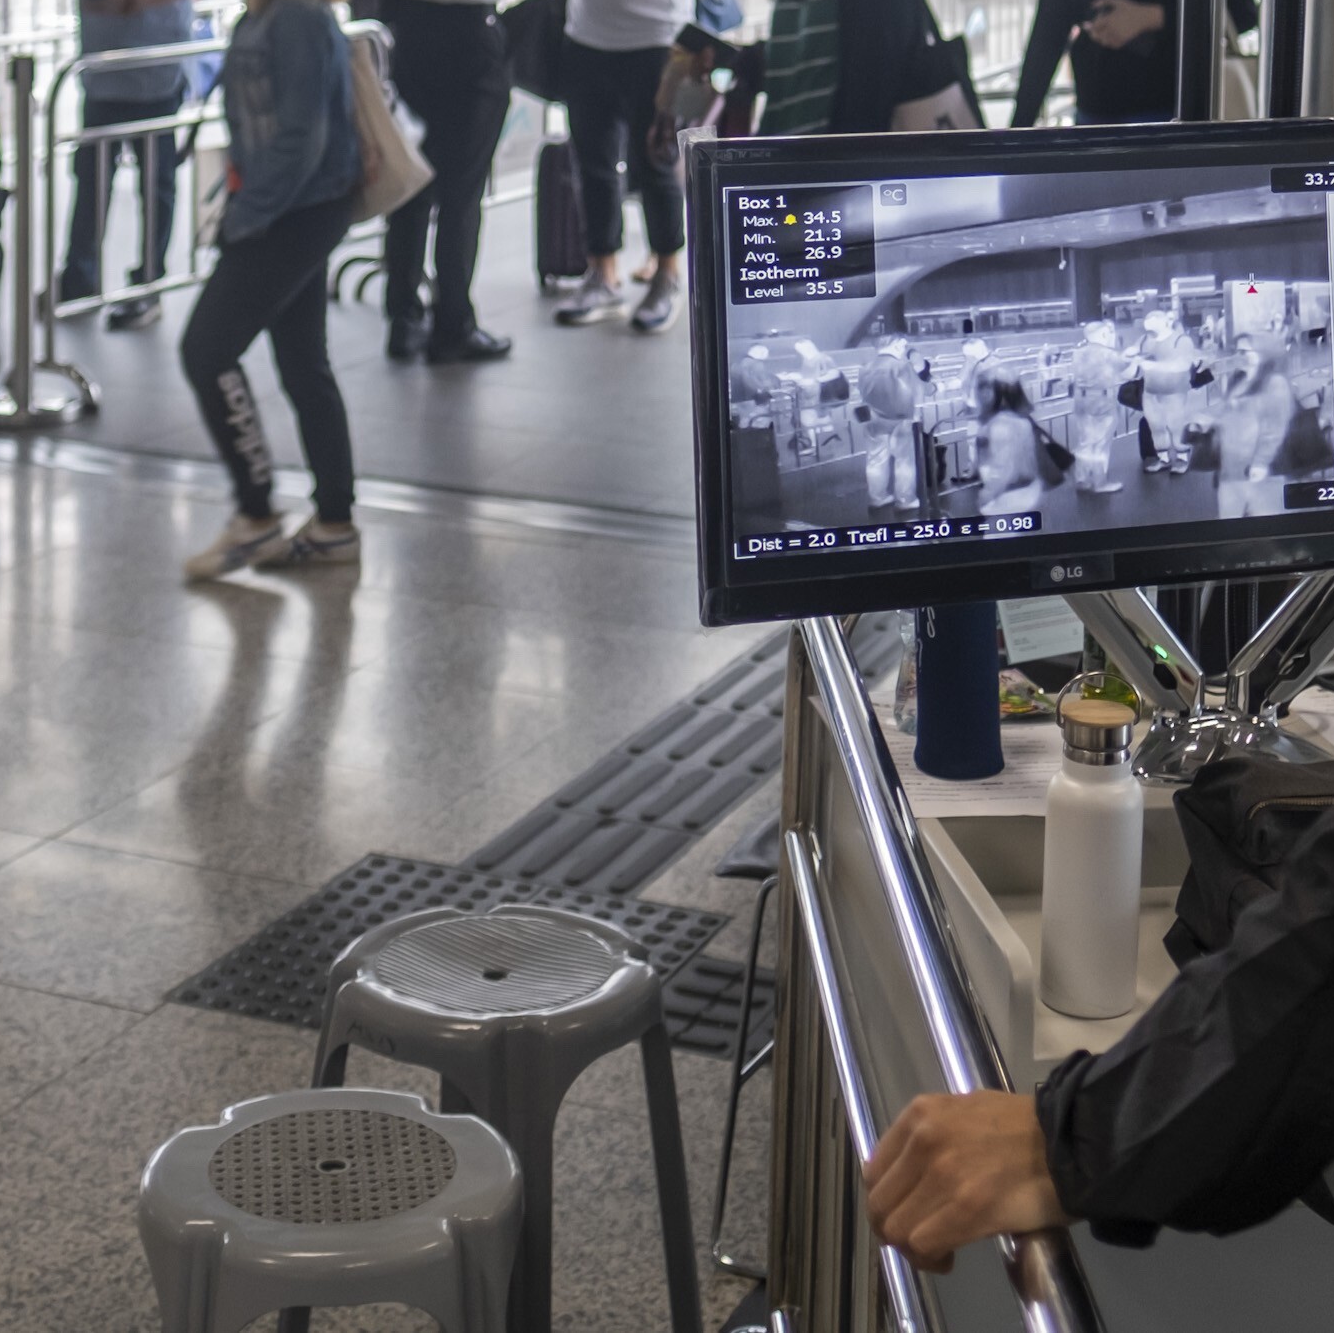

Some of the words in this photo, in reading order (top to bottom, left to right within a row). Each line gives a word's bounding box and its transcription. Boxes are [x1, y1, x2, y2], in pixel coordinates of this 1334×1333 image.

[739, 197, 770, 209] Box
[776, 195, 786, 208] 1
[744, 216, 778, 227] Max.
[804, 211, 841, 224] 34.5
[744, 234, 775, 244] Min.
[805, 228, 841, 242] 21.3
[745, 251, 779, 264] Avg.
[805, 246, 841, 259] 26.9
[740, 266, 819, 280] Isotherm
[746, 285, 783, 298] Level
[806, 281, 843, 294] 35.5
[749, 538, 782, 552] Dist
[809, 534, 835, 547] 2.0
[847, 528, 888, 545] Trefl
[914, 524, 949, 538] 25.0
[996, 517, 1032, 531] 0.98
[1067, 567, 1082, 578] LG
